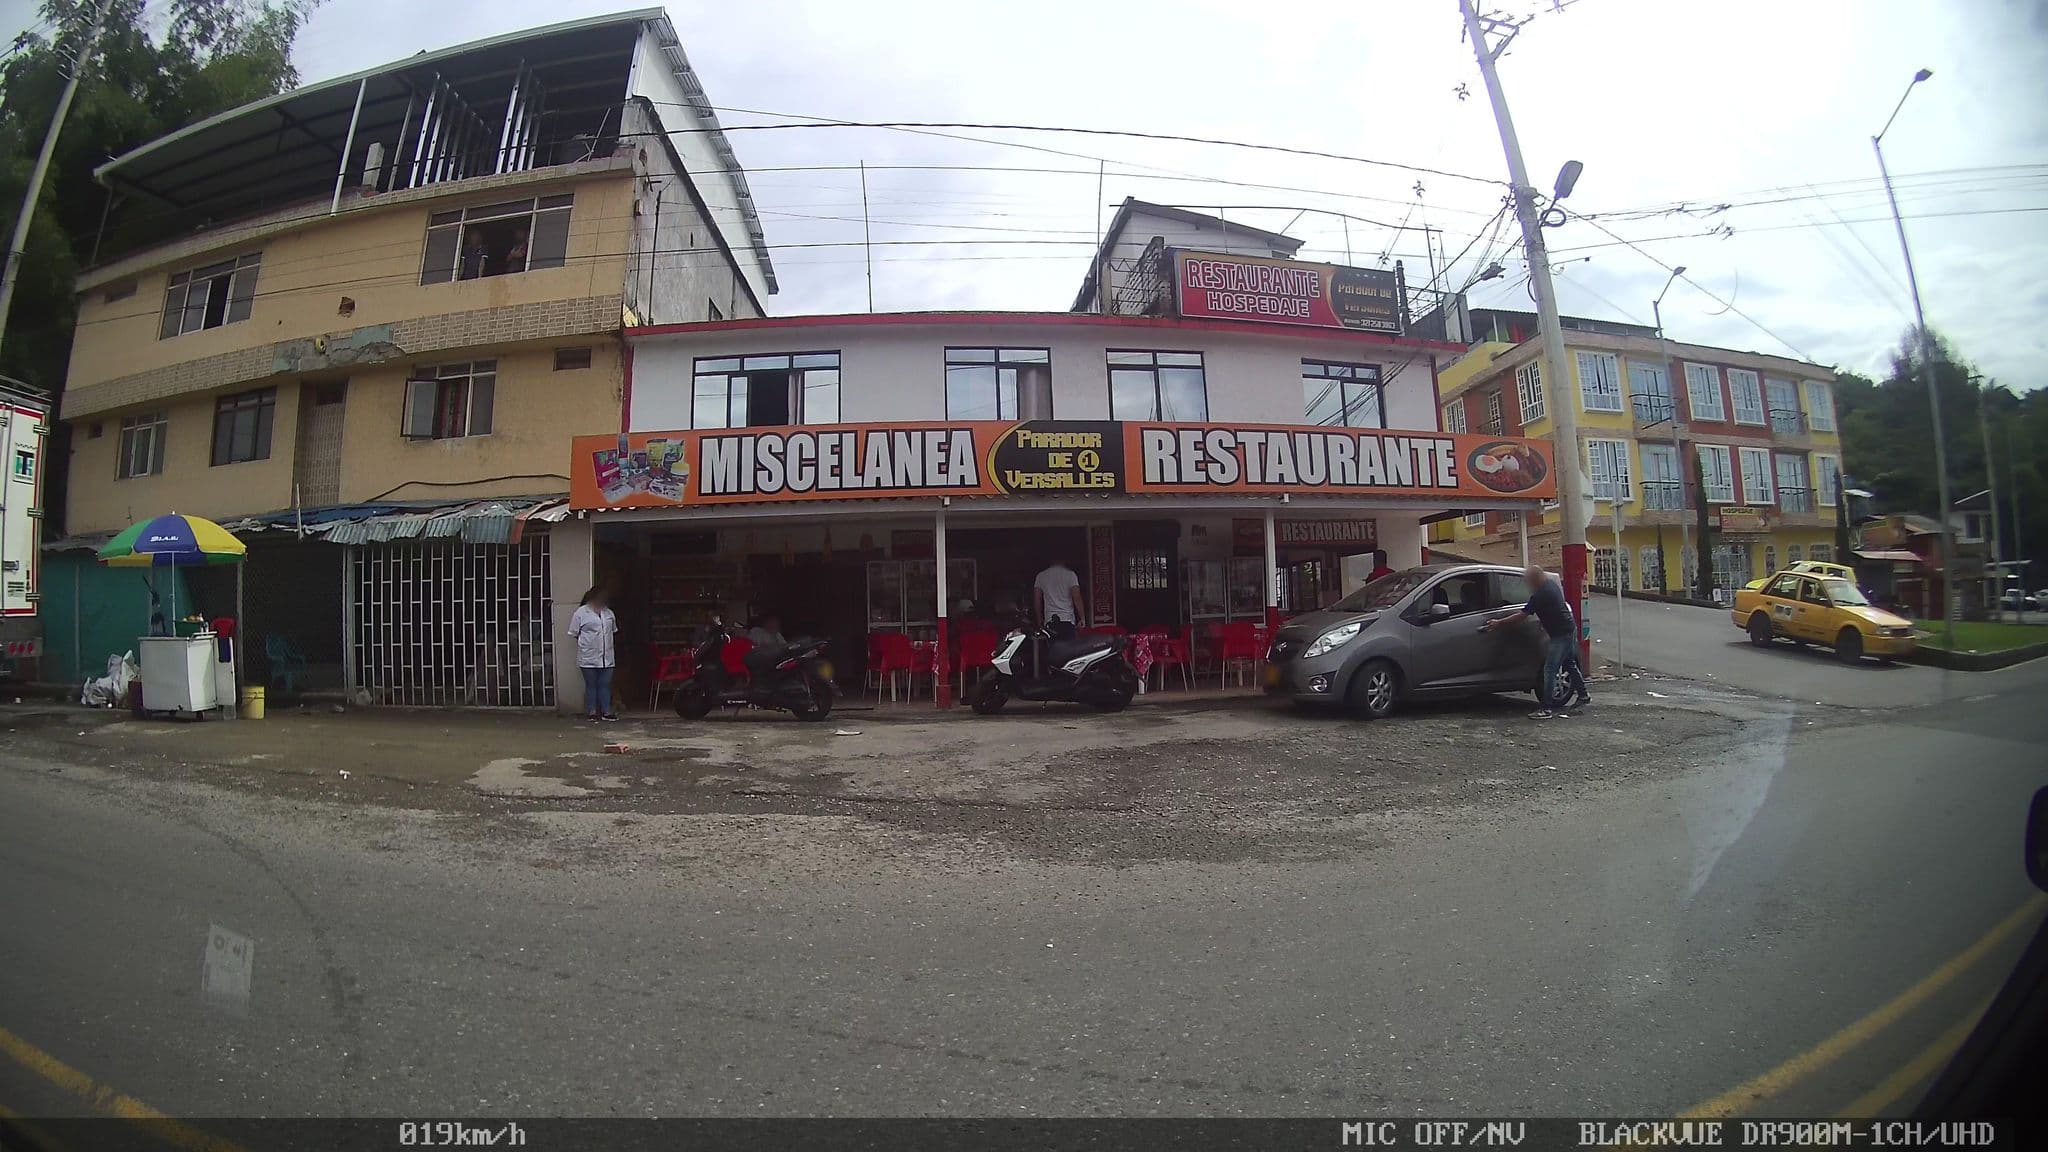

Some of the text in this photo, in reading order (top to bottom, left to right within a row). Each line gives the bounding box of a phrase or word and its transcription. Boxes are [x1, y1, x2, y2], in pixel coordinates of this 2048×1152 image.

[1186, 259, 1321, 298] RESTAURANTE
[1207, 291, 1310, 318] HOSPEDAJE
[1016, 430, 1102, 448] PARADOR
[699, 428, 980, 496] MISCELANEA
[1048, 452, 1073, 468] DE
[1141, 426, 1458, 489] RESTAURANTE
[1005, 470, 1115, 488] VERSALLES
[1280, 521, 1377, 542] RESTAURANTE
